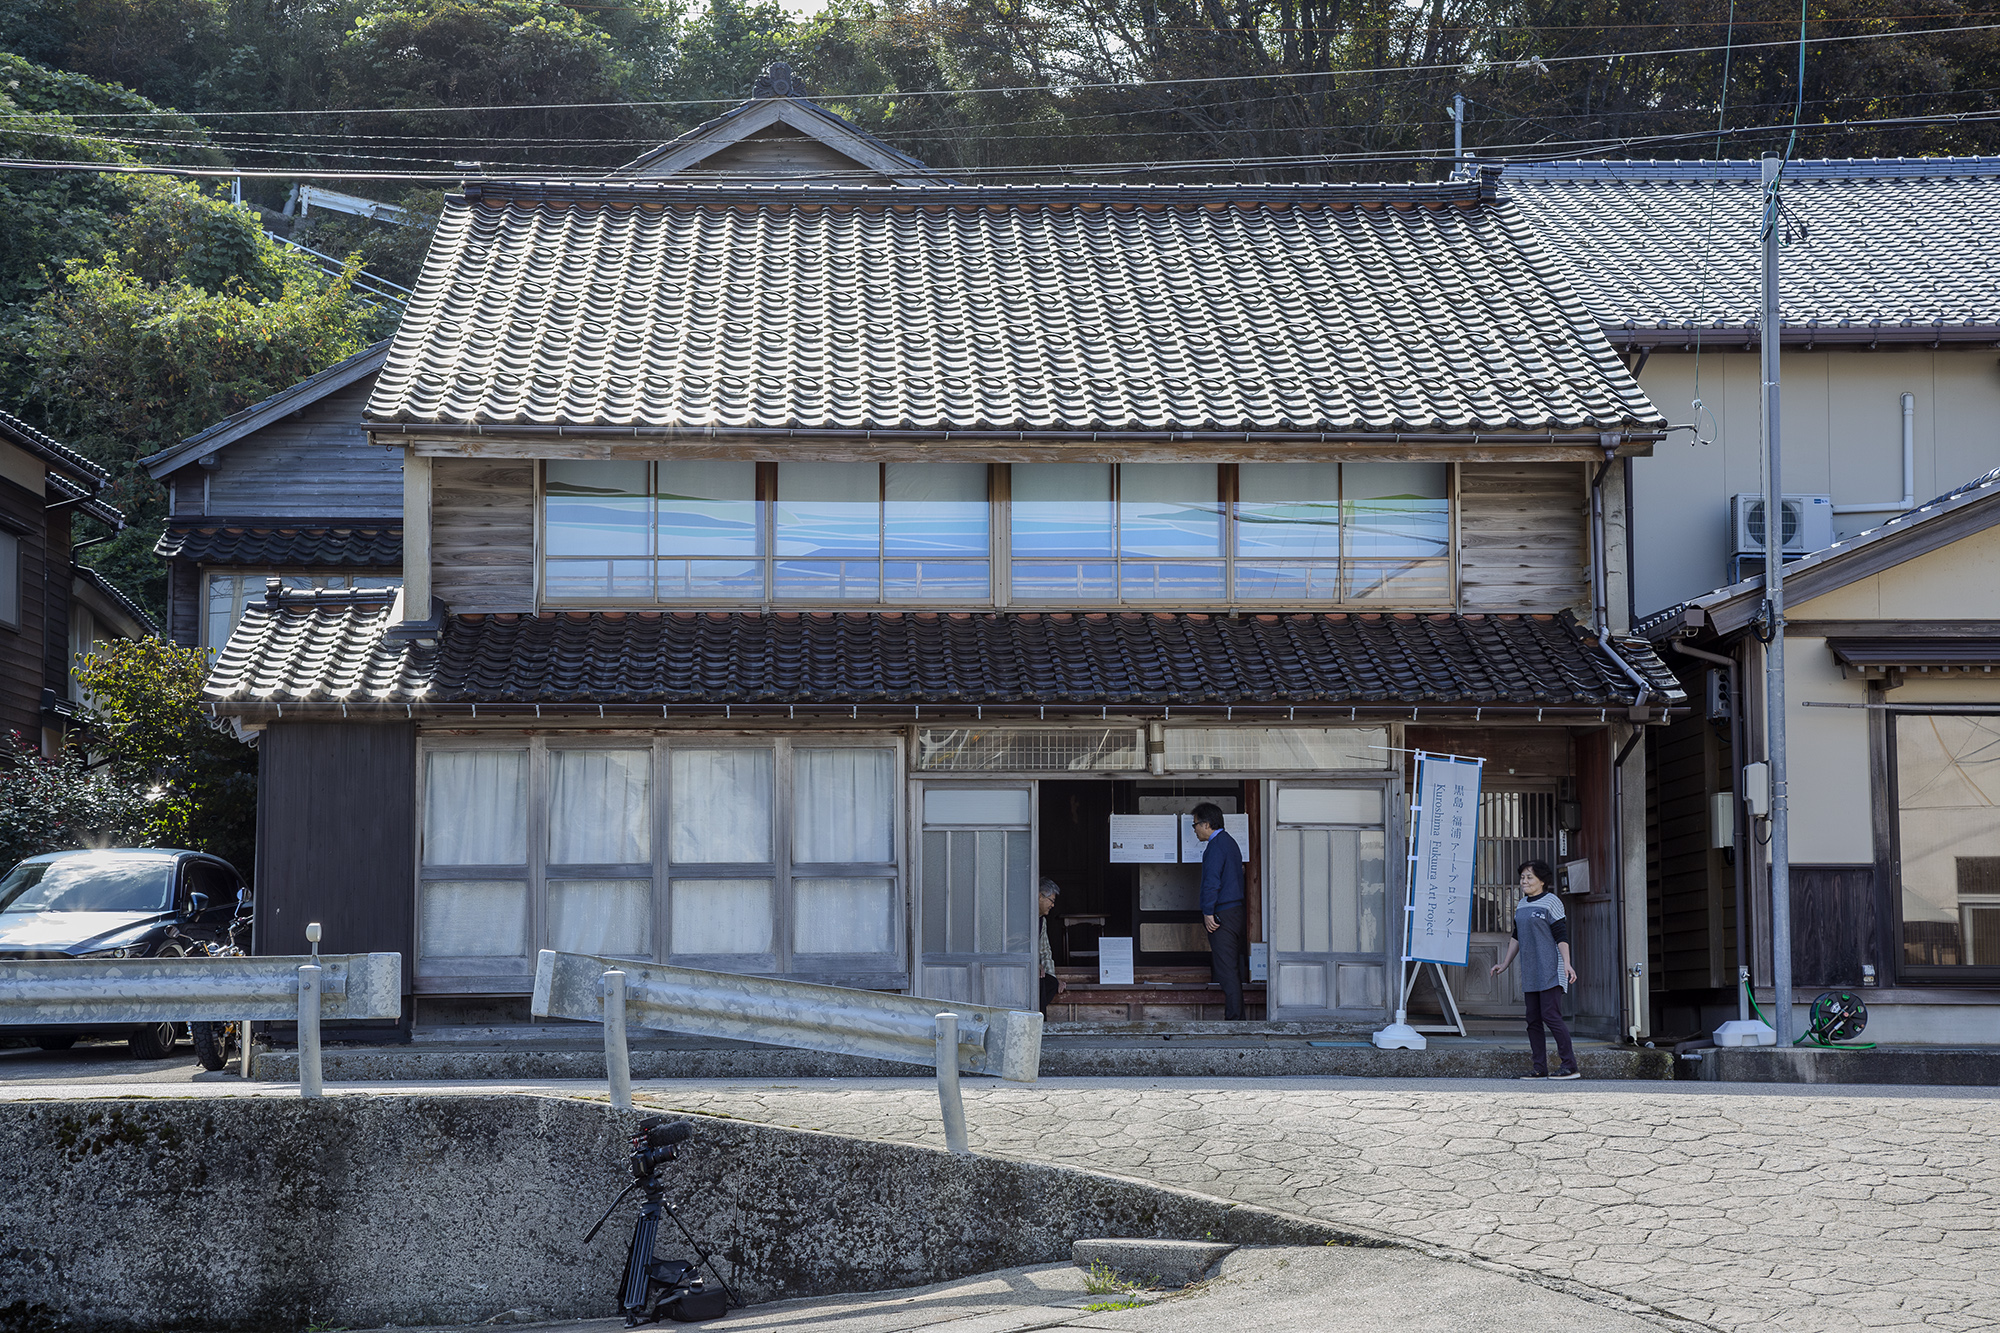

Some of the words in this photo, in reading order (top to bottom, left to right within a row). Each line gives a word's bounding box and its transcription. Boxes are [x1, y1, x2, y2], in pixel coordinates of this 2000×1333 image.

[1433, 784, 1446, 836] Kuroshima
[1430, 841, 1442, 880] Fukuura
[1429, 883, 1438, 900] Art
[1424, 903, 1438, 936] Project
